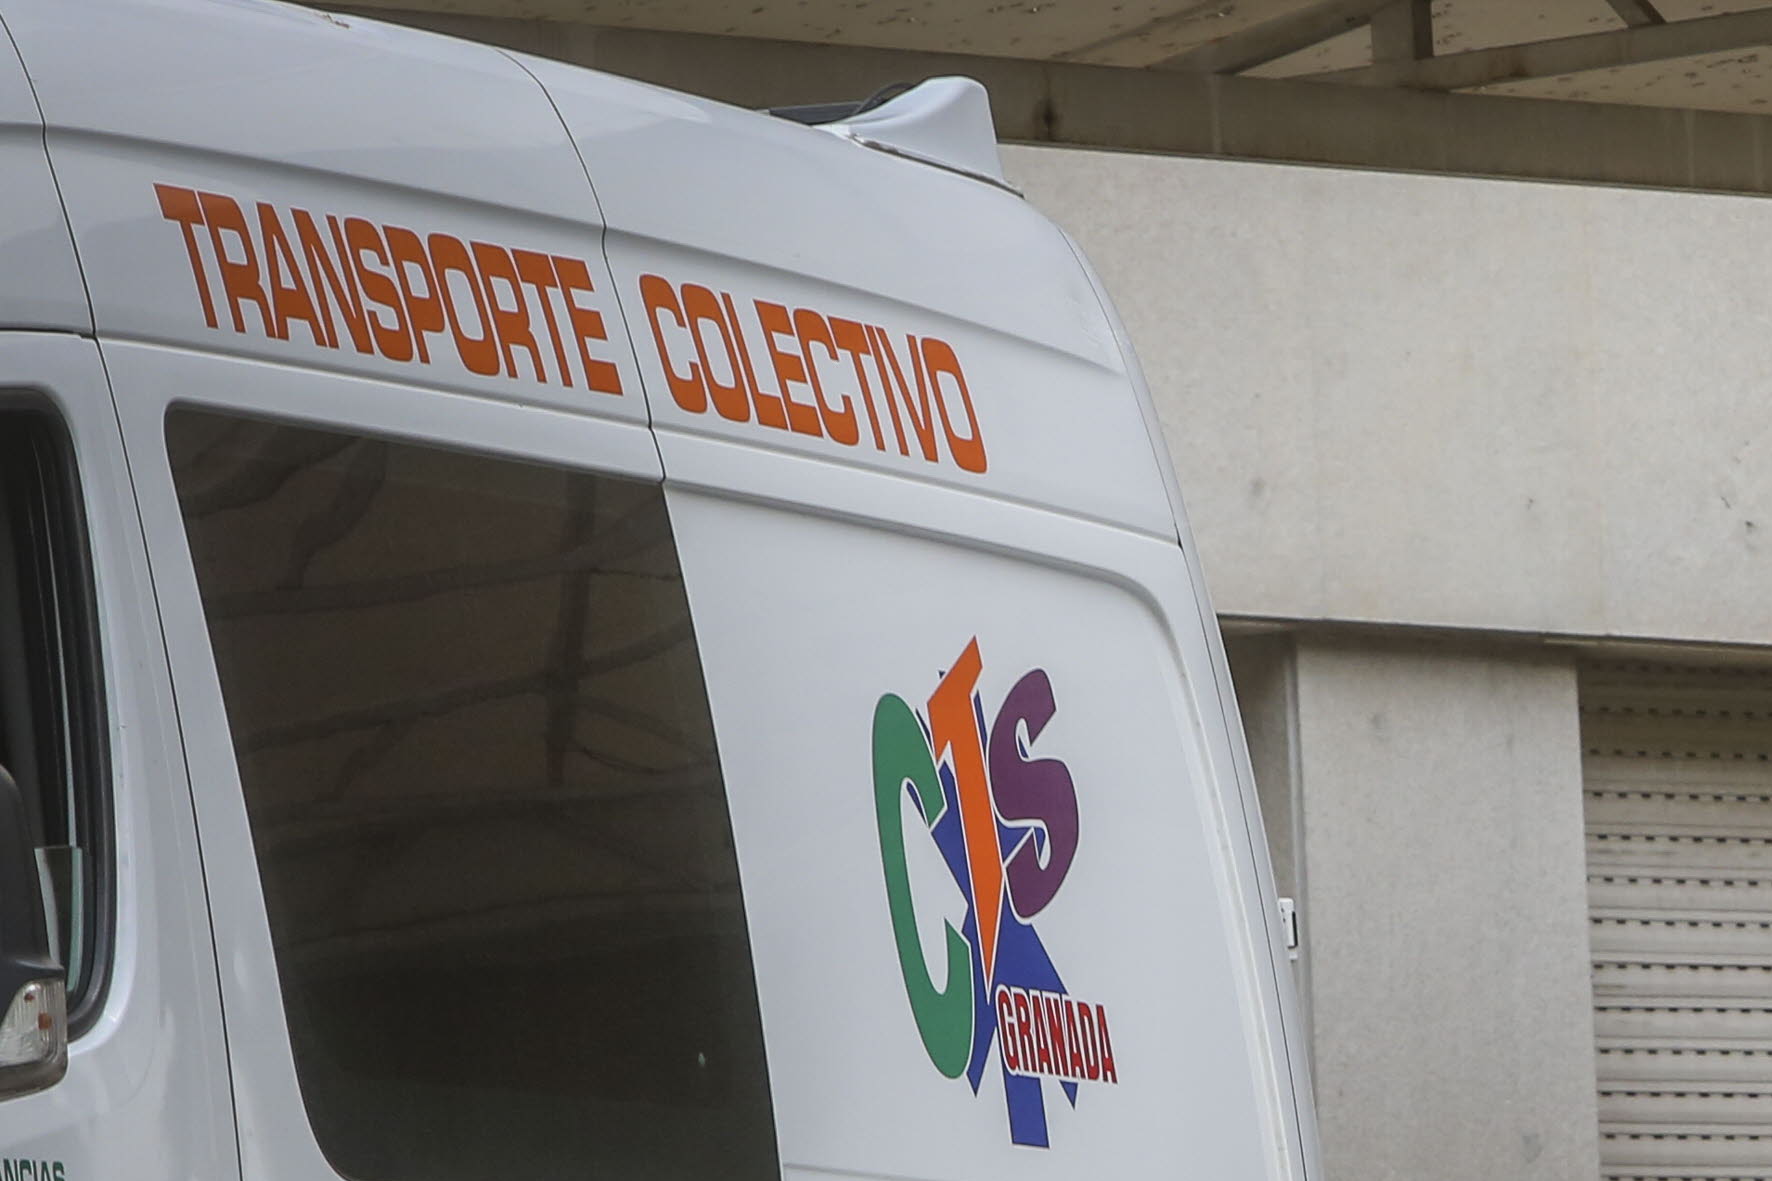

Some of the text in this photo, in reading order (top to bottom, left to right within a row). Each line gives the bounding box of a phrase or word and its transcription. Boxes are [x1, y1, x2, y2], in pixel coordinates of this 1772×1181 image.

[154, 183, 988, 474] TRANSPORTE COLECTIVO
[872, 635, 1079, 1079] CTS
[997, 985, 1118, 1084] GRANADA
